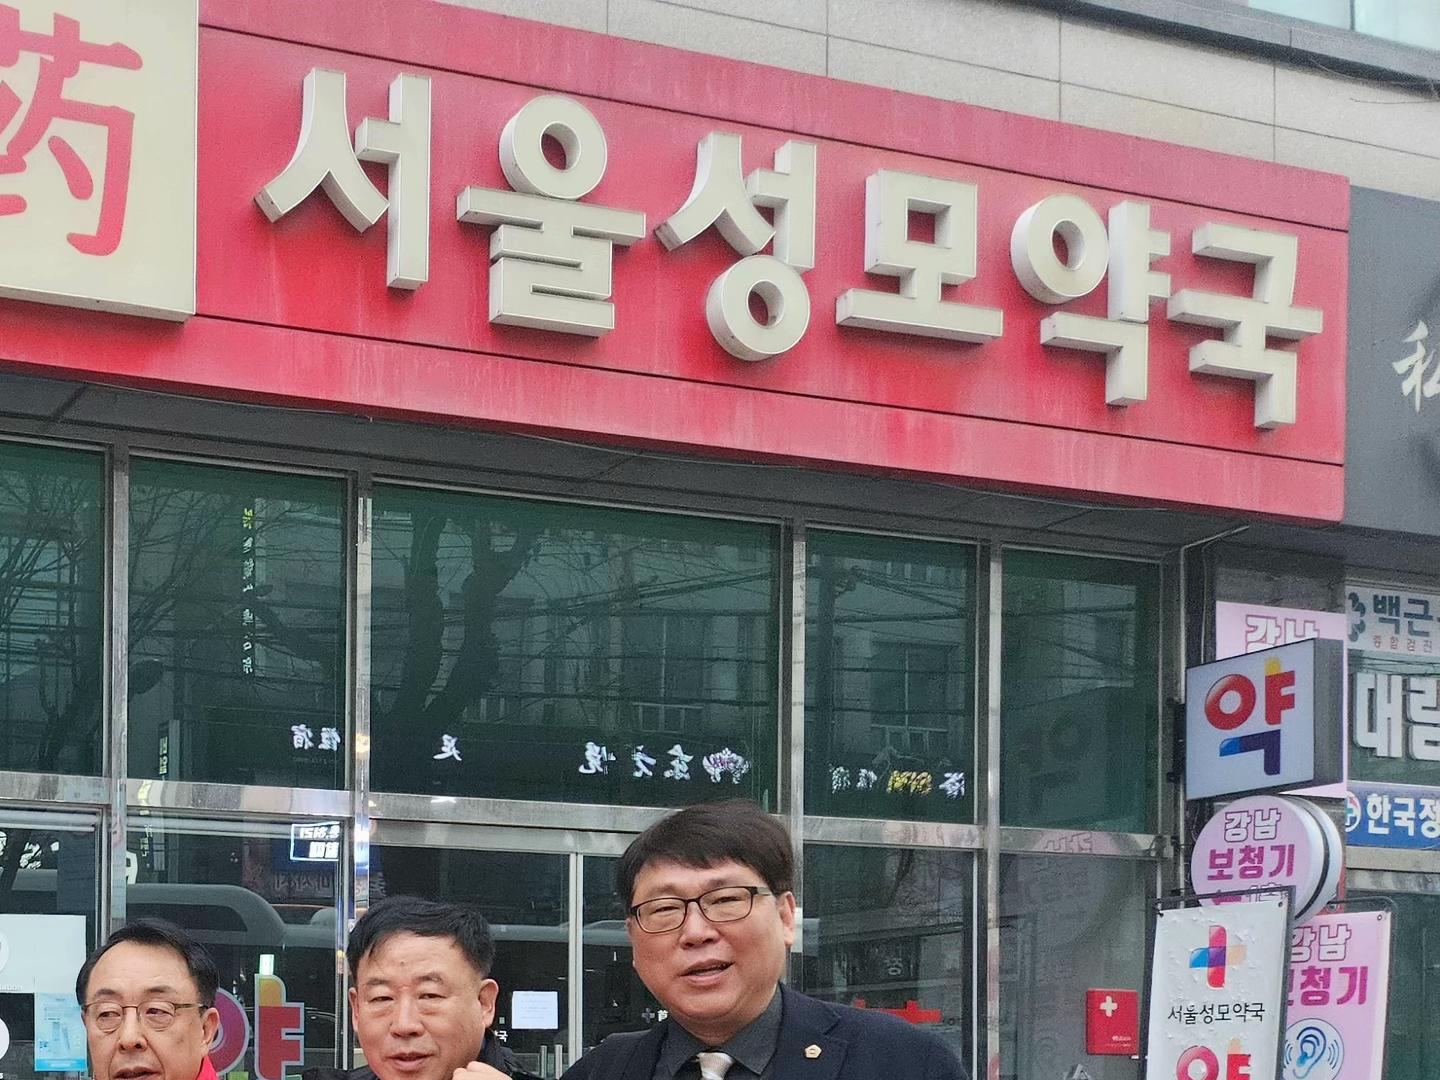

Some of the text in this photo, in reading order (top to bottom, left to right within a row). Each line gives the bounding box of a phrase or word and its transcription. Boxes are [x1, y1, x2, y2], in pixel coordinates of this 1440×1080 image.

[253, 66, 1324, 430] 서울성모약국
[1204, 656, 1296, 776] 약
[1224, 808, 1281, 843] 강남
[1207, 844, 1295, 880] 보청기
[1167, 1001, 1266, 1025] 서울성모약국
